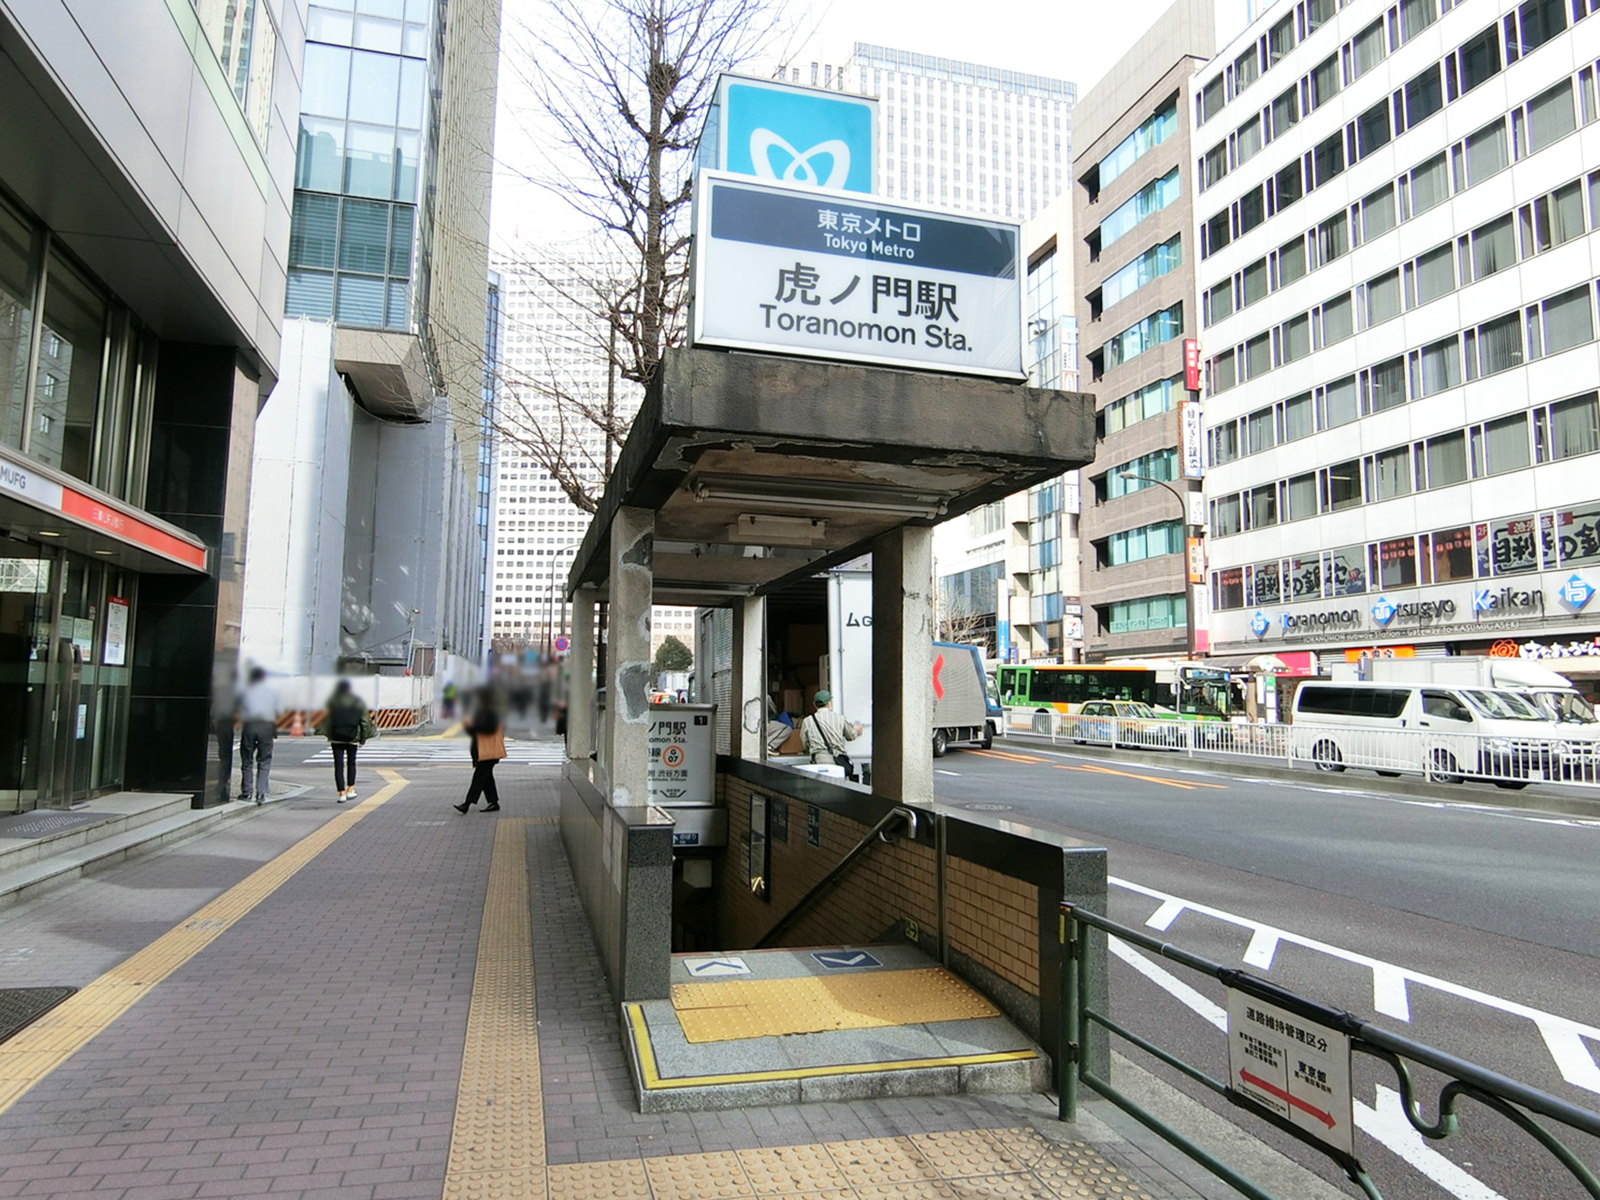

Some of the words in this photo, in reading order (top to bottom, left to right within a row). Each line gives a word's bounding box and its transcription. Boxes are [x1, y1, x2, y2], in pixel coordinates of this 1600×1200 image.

[817, 209, 921, 242] 東京メトロ
[824, 233, 867, 254] Tokyo
[871, 240, 915, 259] Metro
[775, 262, 960, 323] 虎ノ門駅
[760, 304, 916, 345] Toranomon
[925, 325, 973, 352] Sta.
[0, 466, 26, 489] MUFG
[1477, 527, 1487, 537] 2F
[1279, 609, 1359, 627] Toranomon
[1473, 587, 1544, 611] Kaikan
[1407, 627, 1440, 637] Gateway
[1454, 621, 1519, 633] KASUMIGASEKI
[658, 769, 688, 778] 渋谷方面
[1246, 1006, 1328, 1053] 道路維持管理区分
[1298, 1060, 1326, 1083] 東京都
